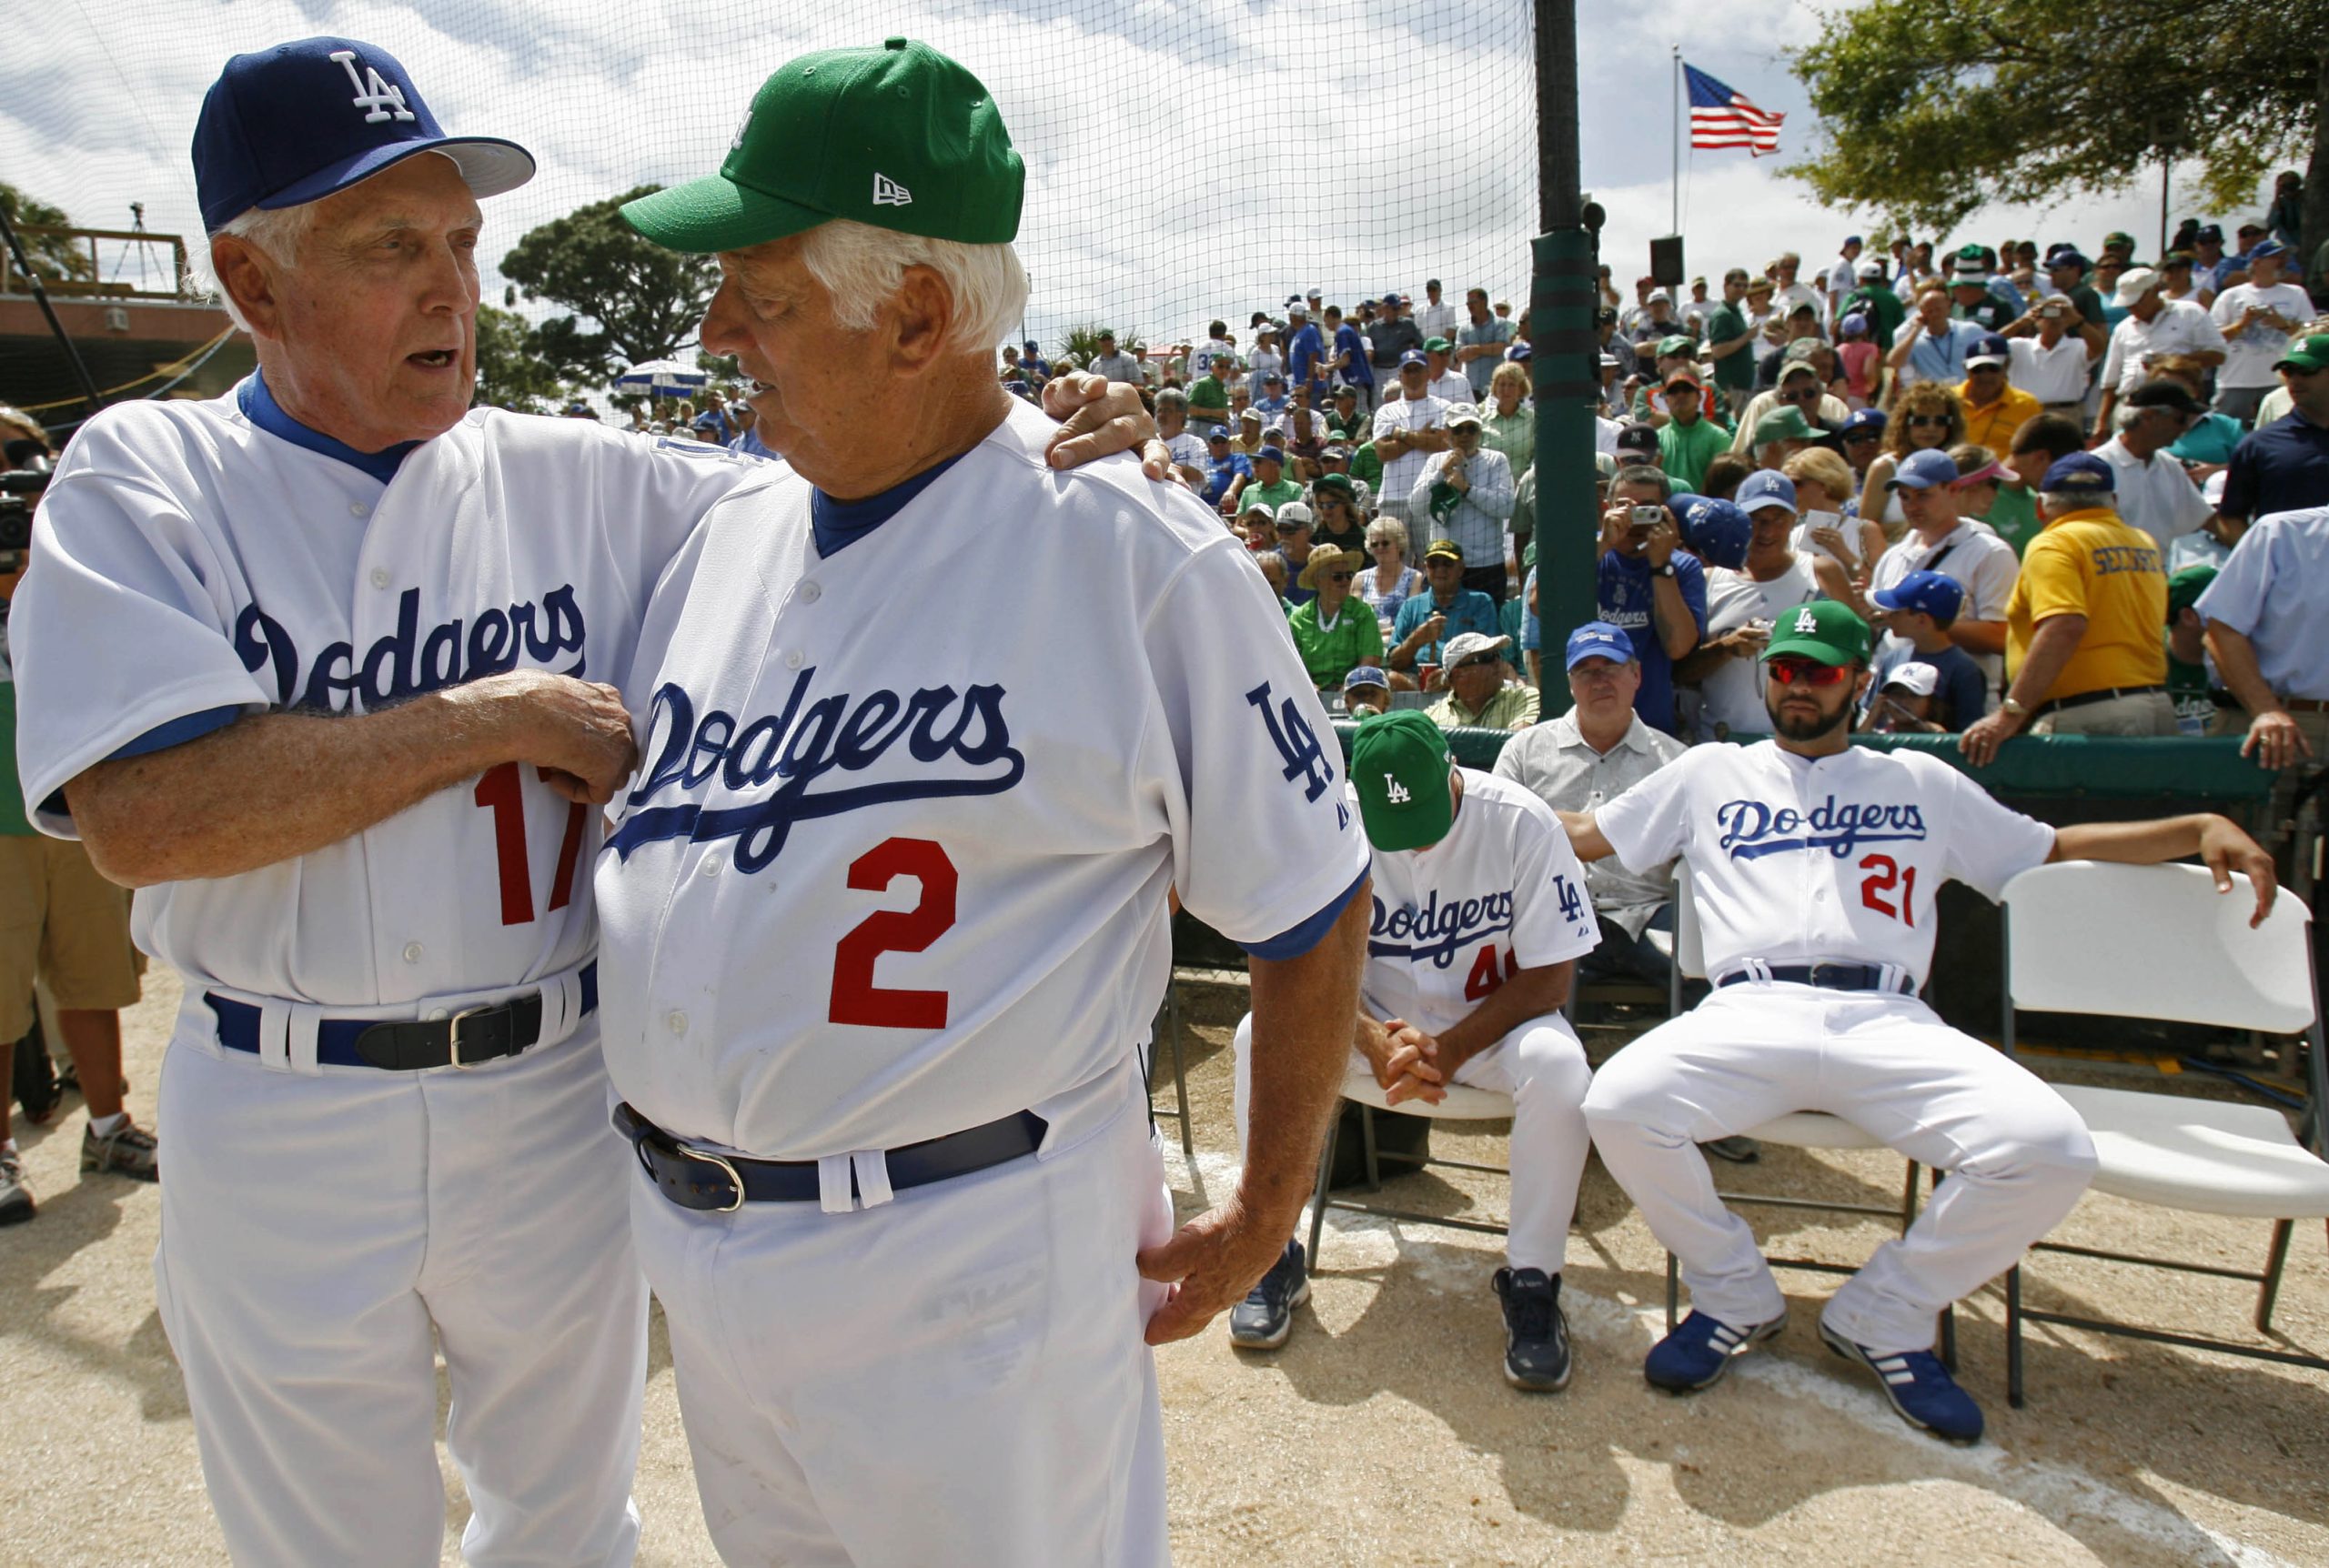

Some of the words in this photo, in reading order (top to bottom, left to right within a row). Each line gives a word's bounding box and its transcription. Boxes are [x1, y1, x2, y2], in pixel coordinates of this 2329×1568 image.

[329, 50, 416, 124] LA
[1793, 608, 1818, 633] LA
[599, 666, 1025, 875] Dodgers
[1245, 679, 1335, 804] LA
[1384, 773, 1411, 804] LA
[1718, 794, 1927, 863] Dodgers
[1552, 874, 1585, 923] LA
[1859, 853, 1917, 929] 21
[828, 836, 959, 1030] 2
